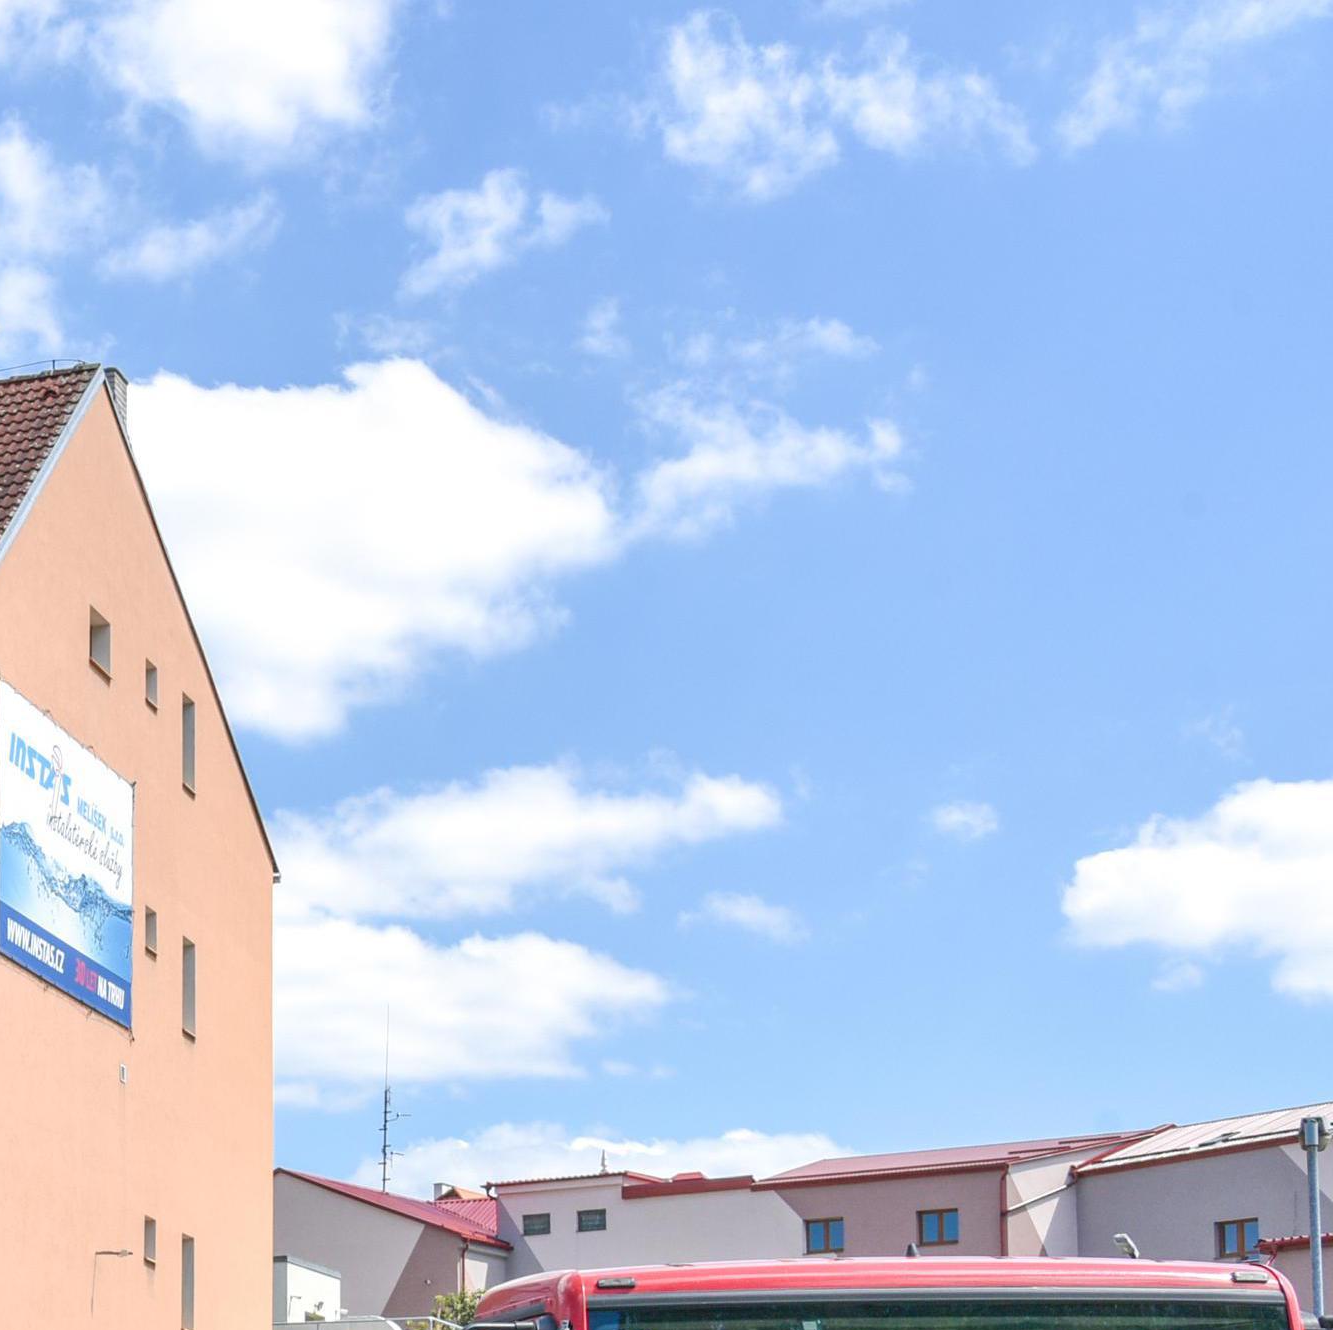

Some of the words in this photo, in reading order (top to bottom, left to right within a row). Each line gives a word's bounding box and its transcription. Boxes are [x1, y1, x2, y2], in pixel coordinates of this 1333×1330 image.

[9, 732, 71, 806] INSTAS
[7, 917, 65, 974] WWW.INSTAS.CZ
[97, 975, 107, 1001] NA
[107, 981, 125, 1010] TRHU
